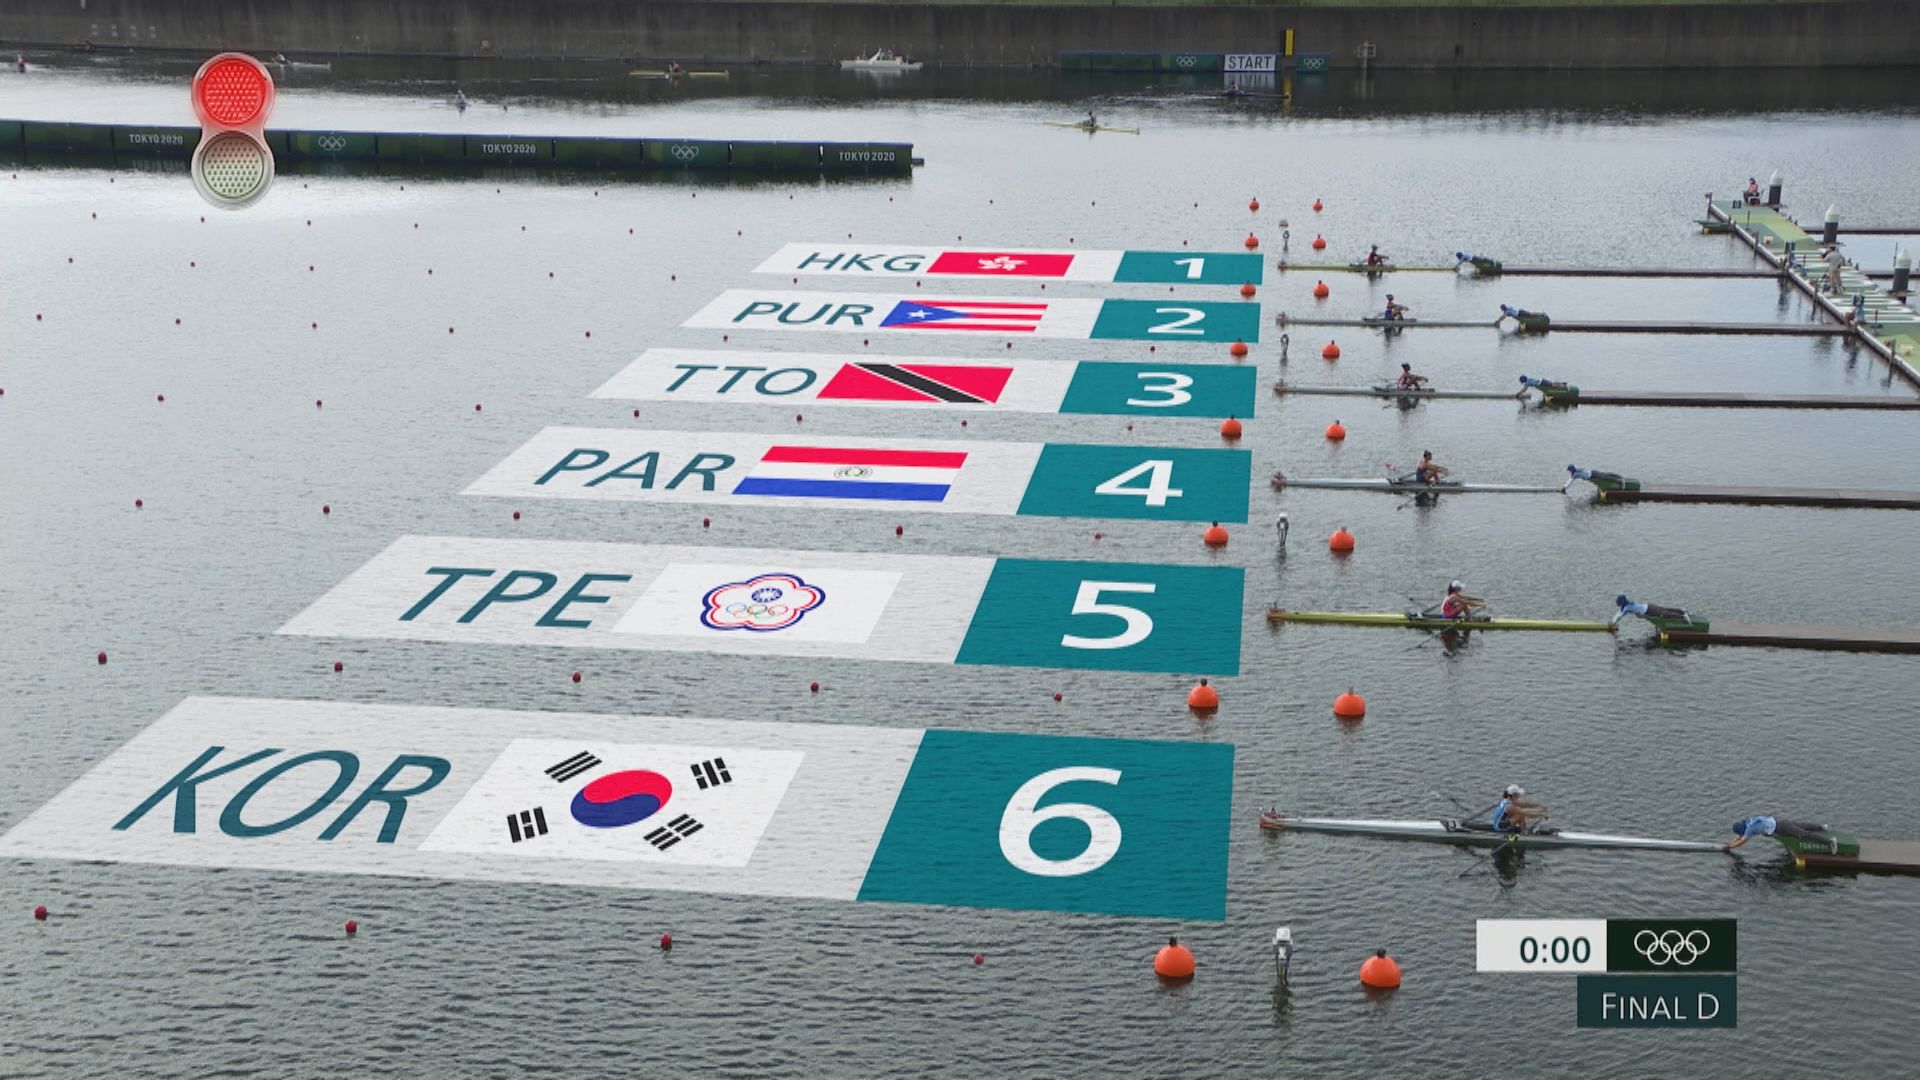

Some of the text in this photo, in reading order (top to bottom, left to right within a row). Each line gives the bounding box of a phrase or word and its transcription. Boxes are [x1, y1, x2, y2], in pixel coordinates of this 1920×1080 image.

[1228, 56, 1272, 69] START
[129, 134, 184, 145] TOKYO 2020
[482, 144, 537, 153] TOKYO 2020
[839, 152, 896, 161] TOKYO 2020
